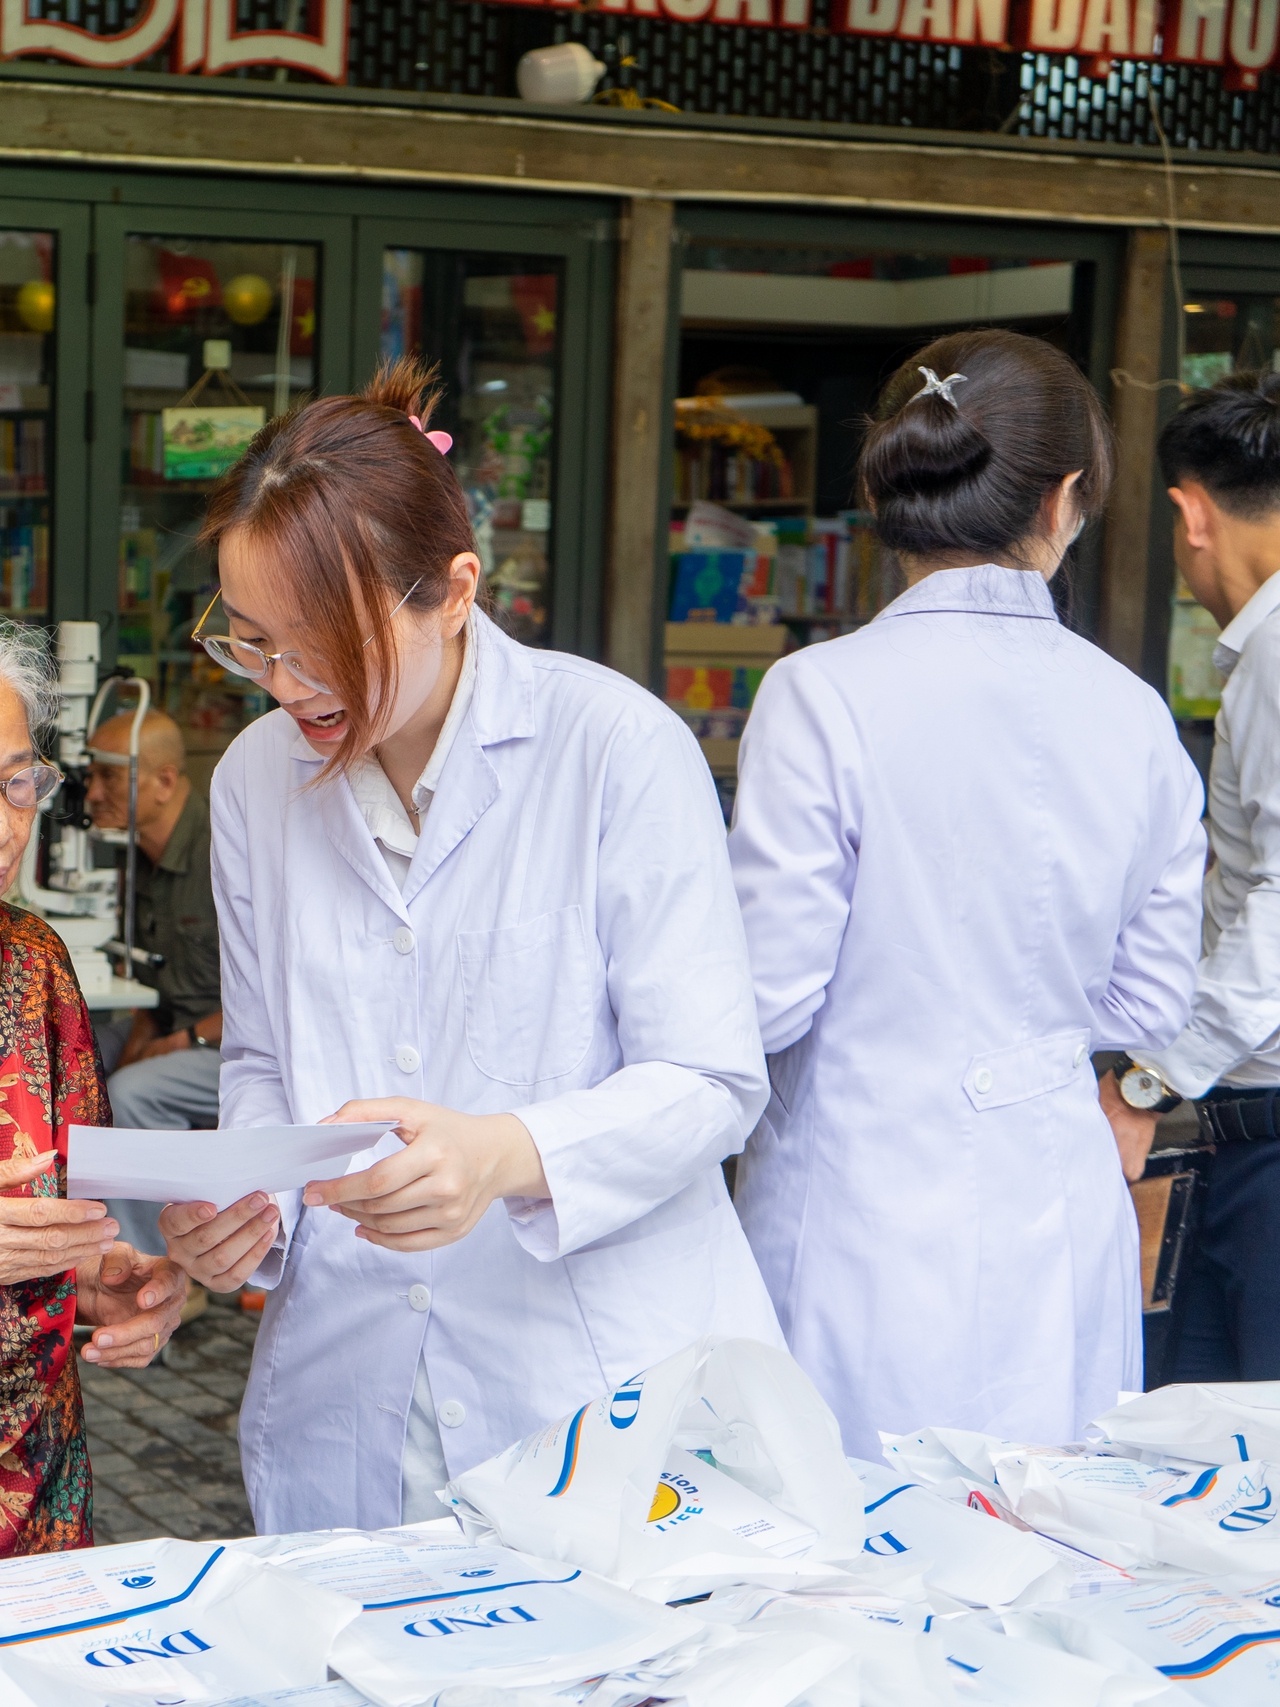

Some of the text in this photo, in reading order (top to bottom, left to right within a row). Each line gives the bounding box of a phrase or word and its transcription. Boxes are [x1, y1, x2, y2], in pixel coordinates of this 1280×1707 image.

[659, 1470, 699, 1495] sion
[402, 1604, 542, 1639] DND
[83, 1628, 217, 1669] DND
